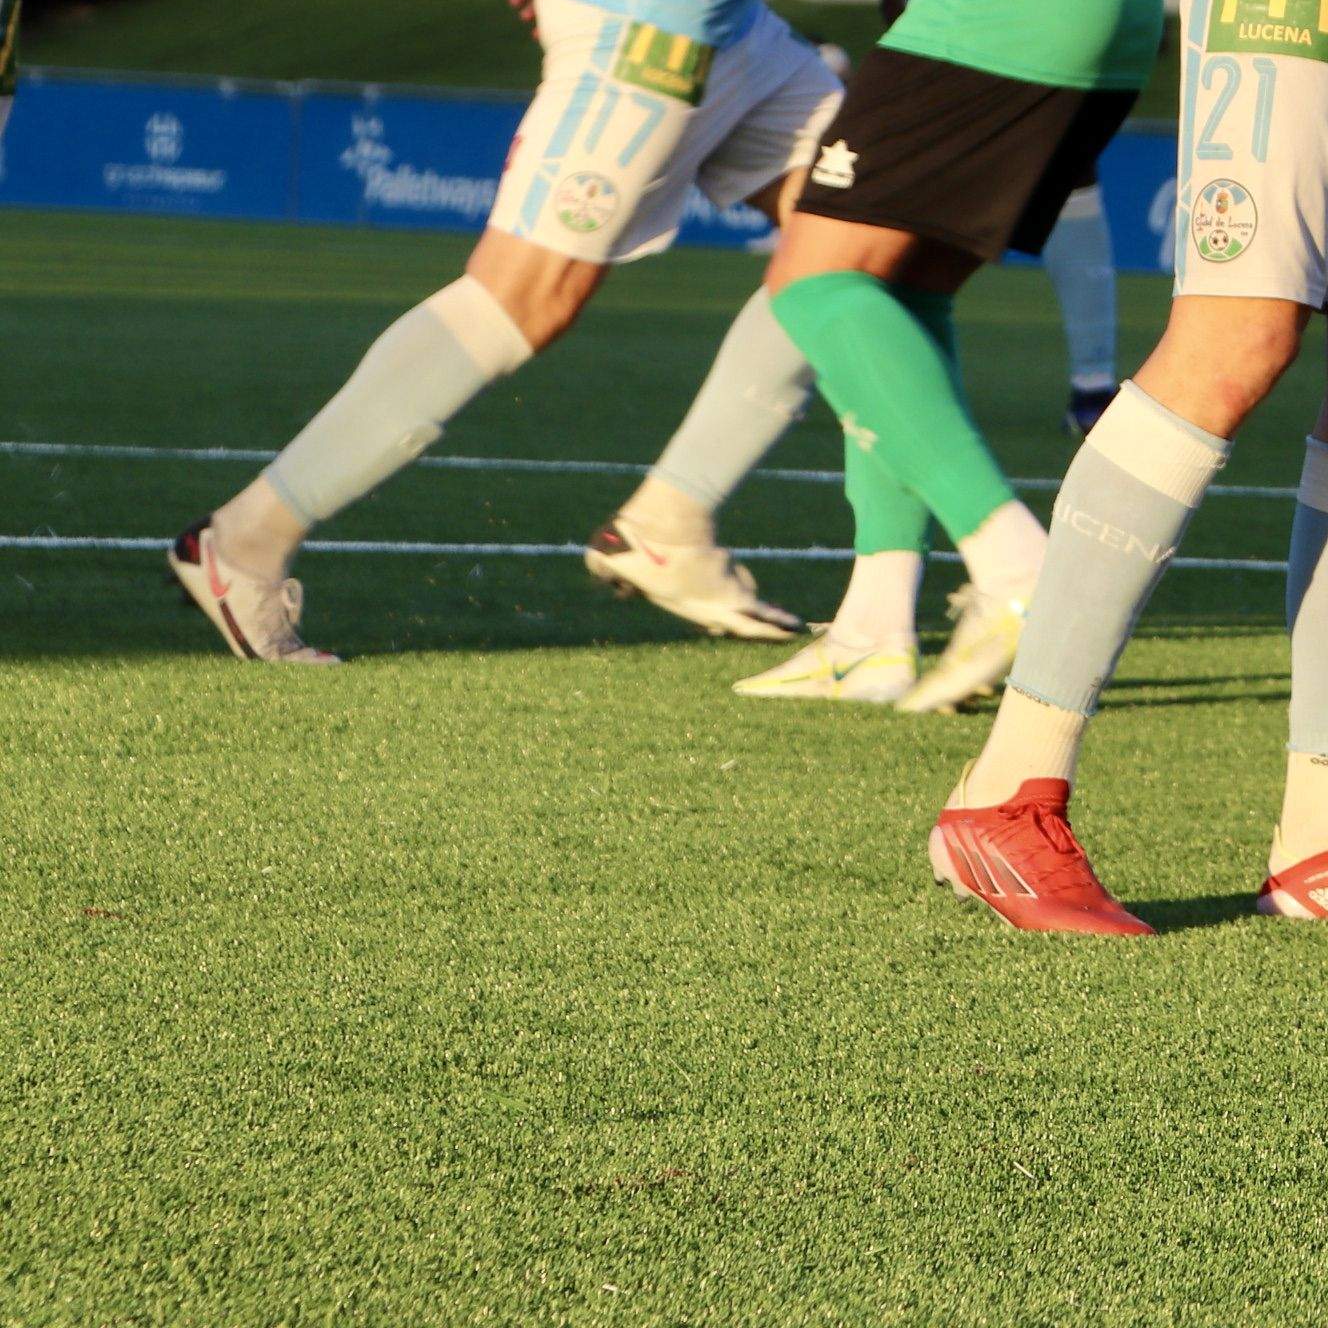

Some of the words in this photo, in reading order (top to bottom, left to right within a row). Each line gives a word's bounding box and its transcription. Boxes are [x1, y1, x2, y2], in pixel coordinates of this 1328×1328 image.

[1238, 22, 1313, 47] LUCENA
[583, 82, 667, 169] 17
[1195, 55, 1277, 163] 21
